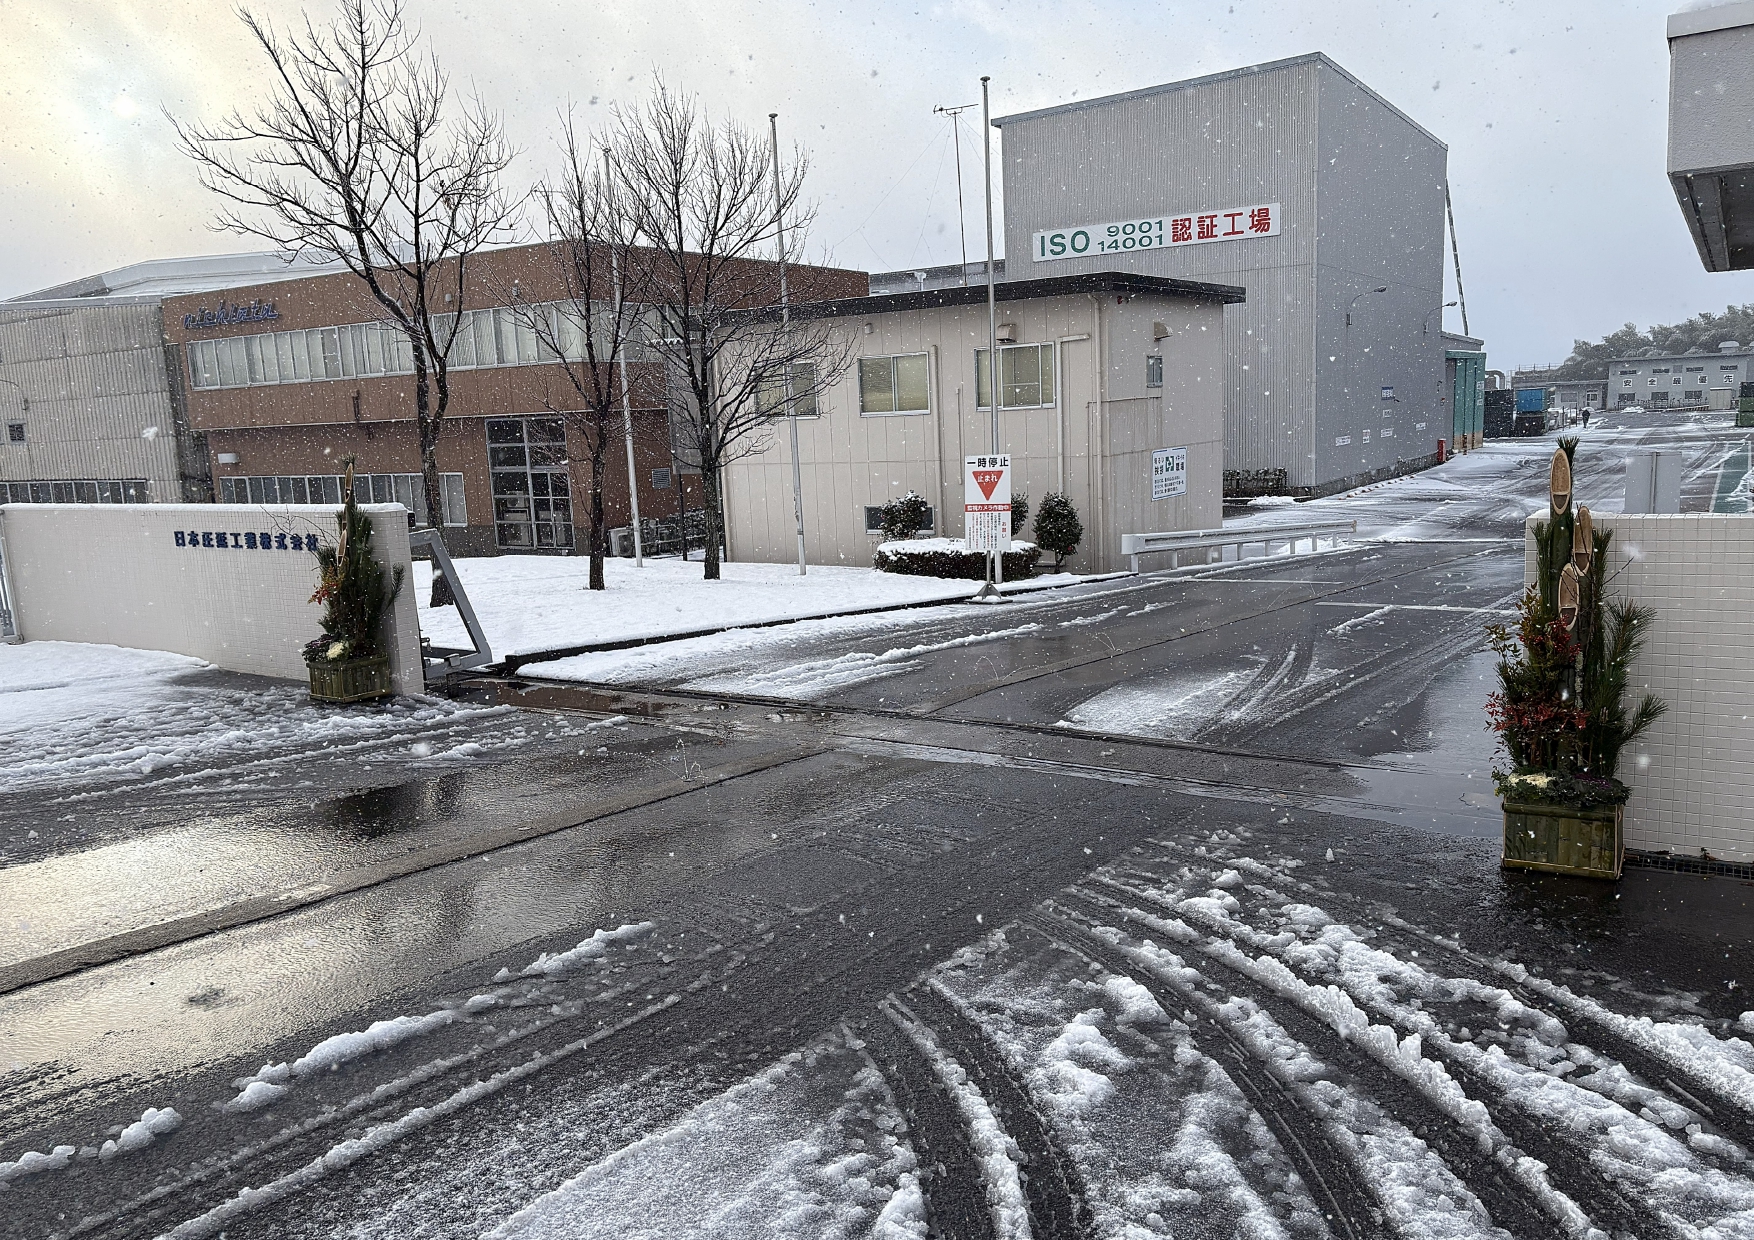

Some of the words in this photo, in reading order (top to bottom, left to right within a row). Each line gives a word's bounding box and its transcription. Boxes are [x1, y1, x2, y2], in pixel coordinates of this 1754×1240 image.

[1171, 207, 1272, 243] 認証工場
[1040, 230, 1090, 257] ISO
[1106, 219, 1164, 238] 9001
[1097, 233, 1164, 252] 14001
[1623, 374, 1734, 387] 安全最優先
[966, 456, 1009, 468] 一時停止
[977, 473, 998, 483] 止まれ
[173, 530, 319, 552] 日本圧延工業株式会社
